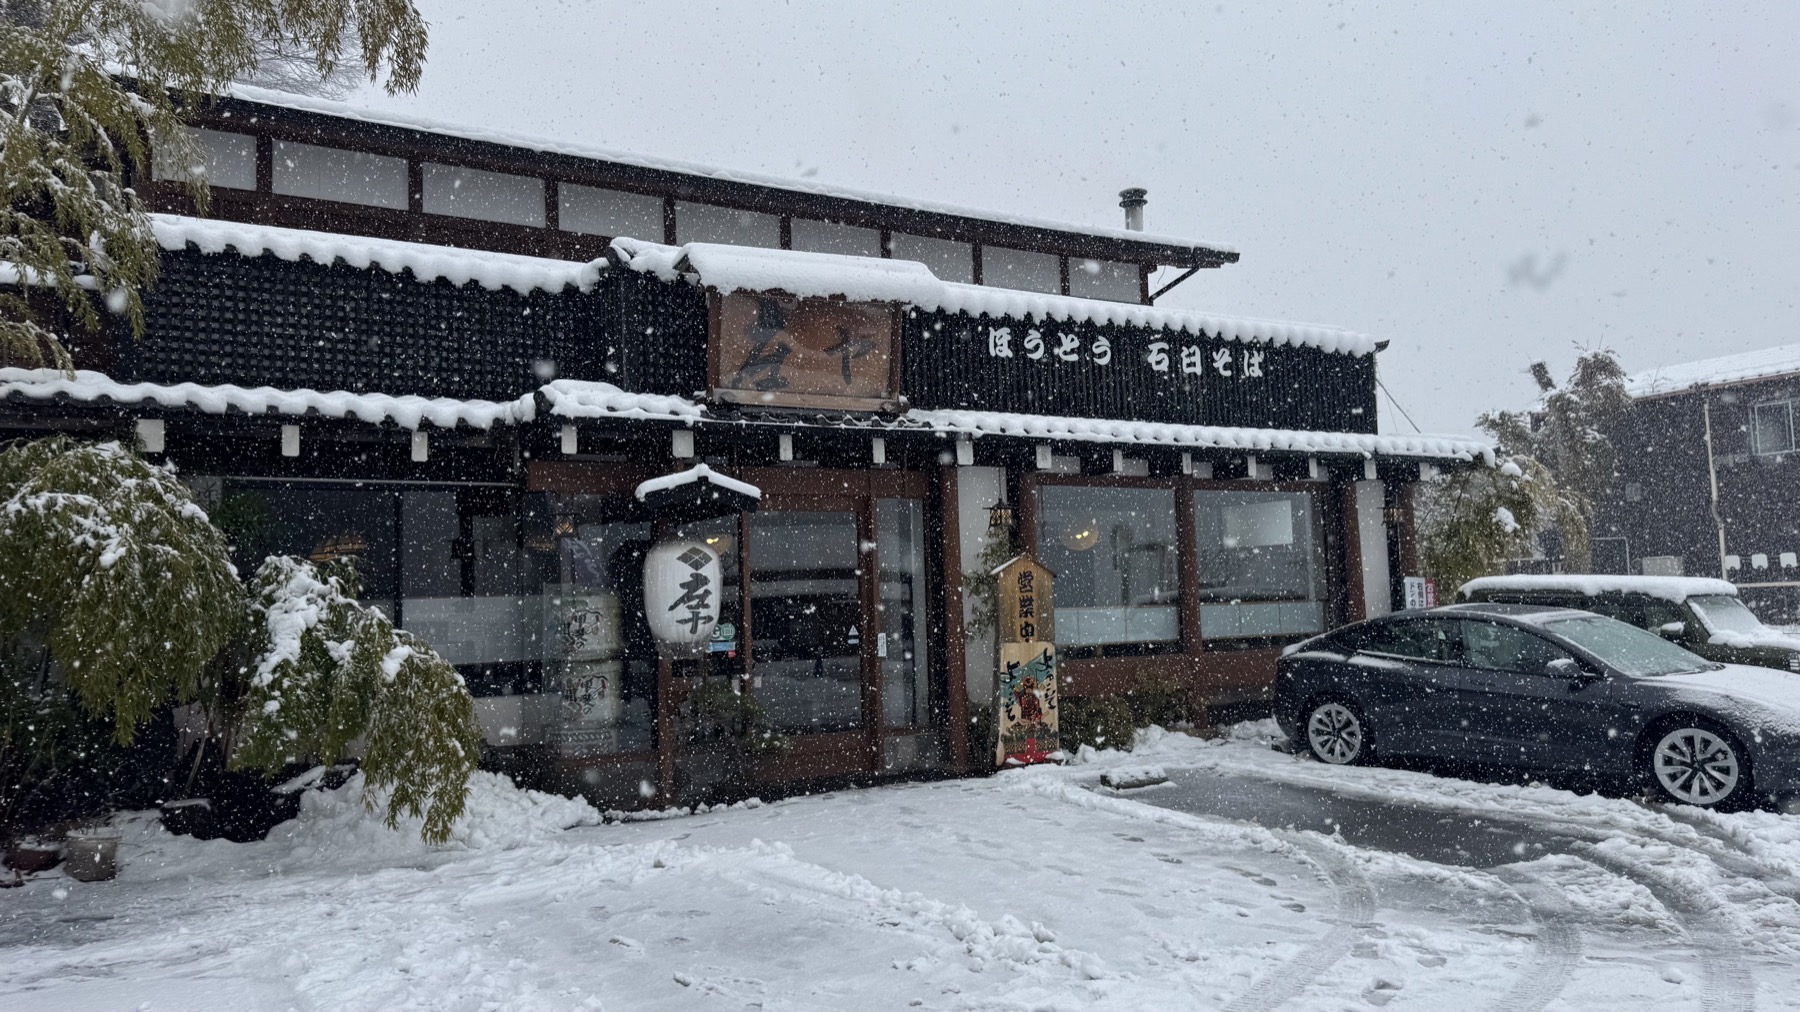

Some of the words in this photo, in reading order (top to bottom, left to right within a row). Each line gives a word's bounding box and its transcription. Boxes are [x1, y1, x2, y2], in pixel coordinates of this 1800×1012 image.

[988, 326, 1112, 365] ほうとう
[1147, 341, 1265, 378] 石臼そば
[1018, 570, 1035, 643] 営業中
